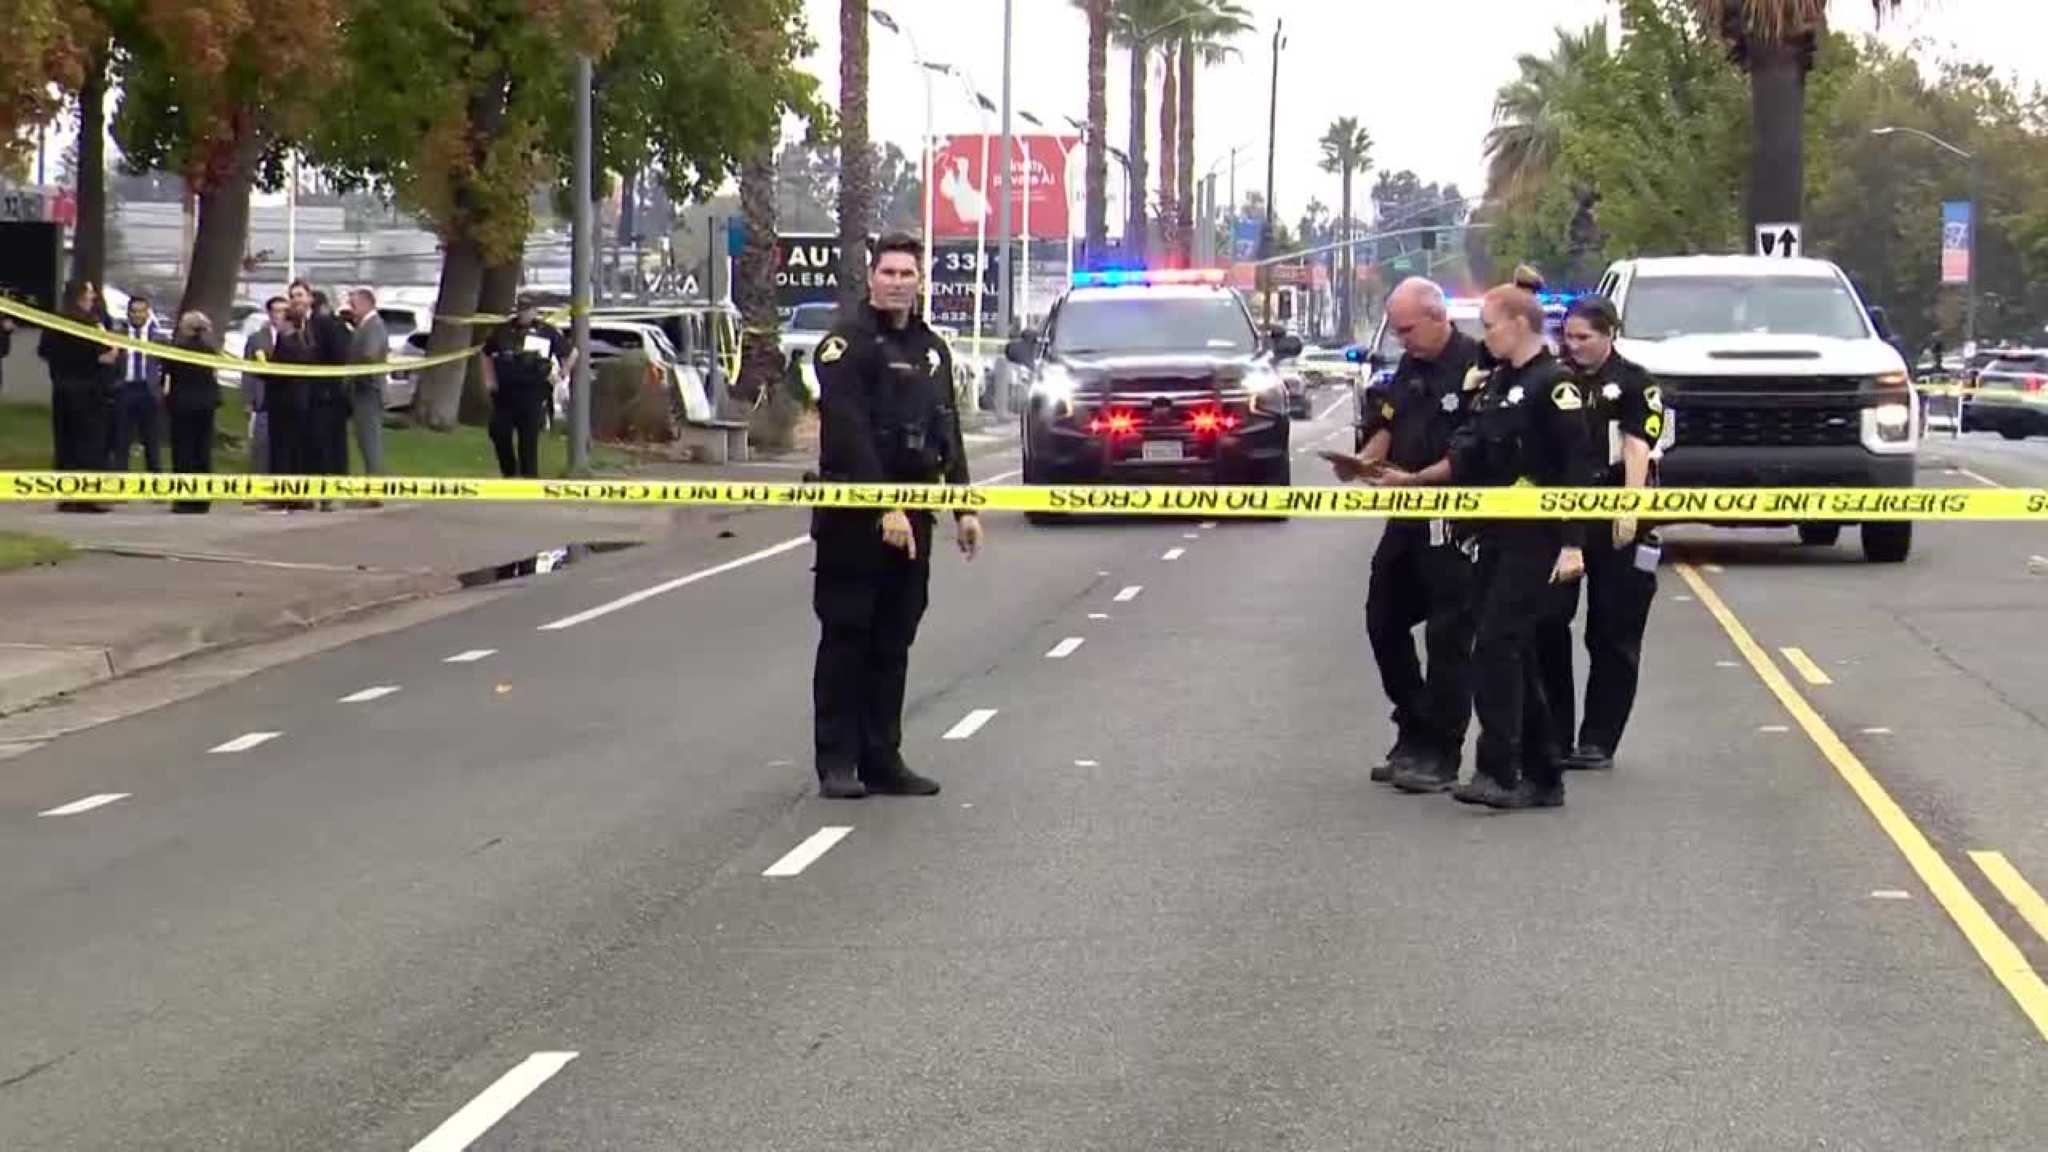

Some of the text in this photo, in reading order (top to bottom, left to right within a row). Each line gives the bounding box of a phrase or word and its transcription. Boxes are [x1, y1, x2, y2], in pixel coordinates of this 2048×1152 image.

[776, 272, 838, 287] OLESA
[13, 476, 126, 495] CROSS
[137, 477, 197, 496] NOT
[206, 478, 251, 495] DO
[542, 484, 650, 499] CROSS
[662, 484, 718, 500] NOT
[727, 484, 770, 501] DO
[775, 485, 841, 504] LINE
[1049, 488, 1152, 508] CROSS
[1158, 488, 1219, 509] NOT
[1226, 489, 1269, 509] DO
[1274, 491, 1338, 511] LINE
[1540, 491, 1642, 512] CROSS
[1645, 491, 1708, 512] NOT
[1714, 492, 1758, 512] DO
[1762, 492, 1827, 512] LINE
